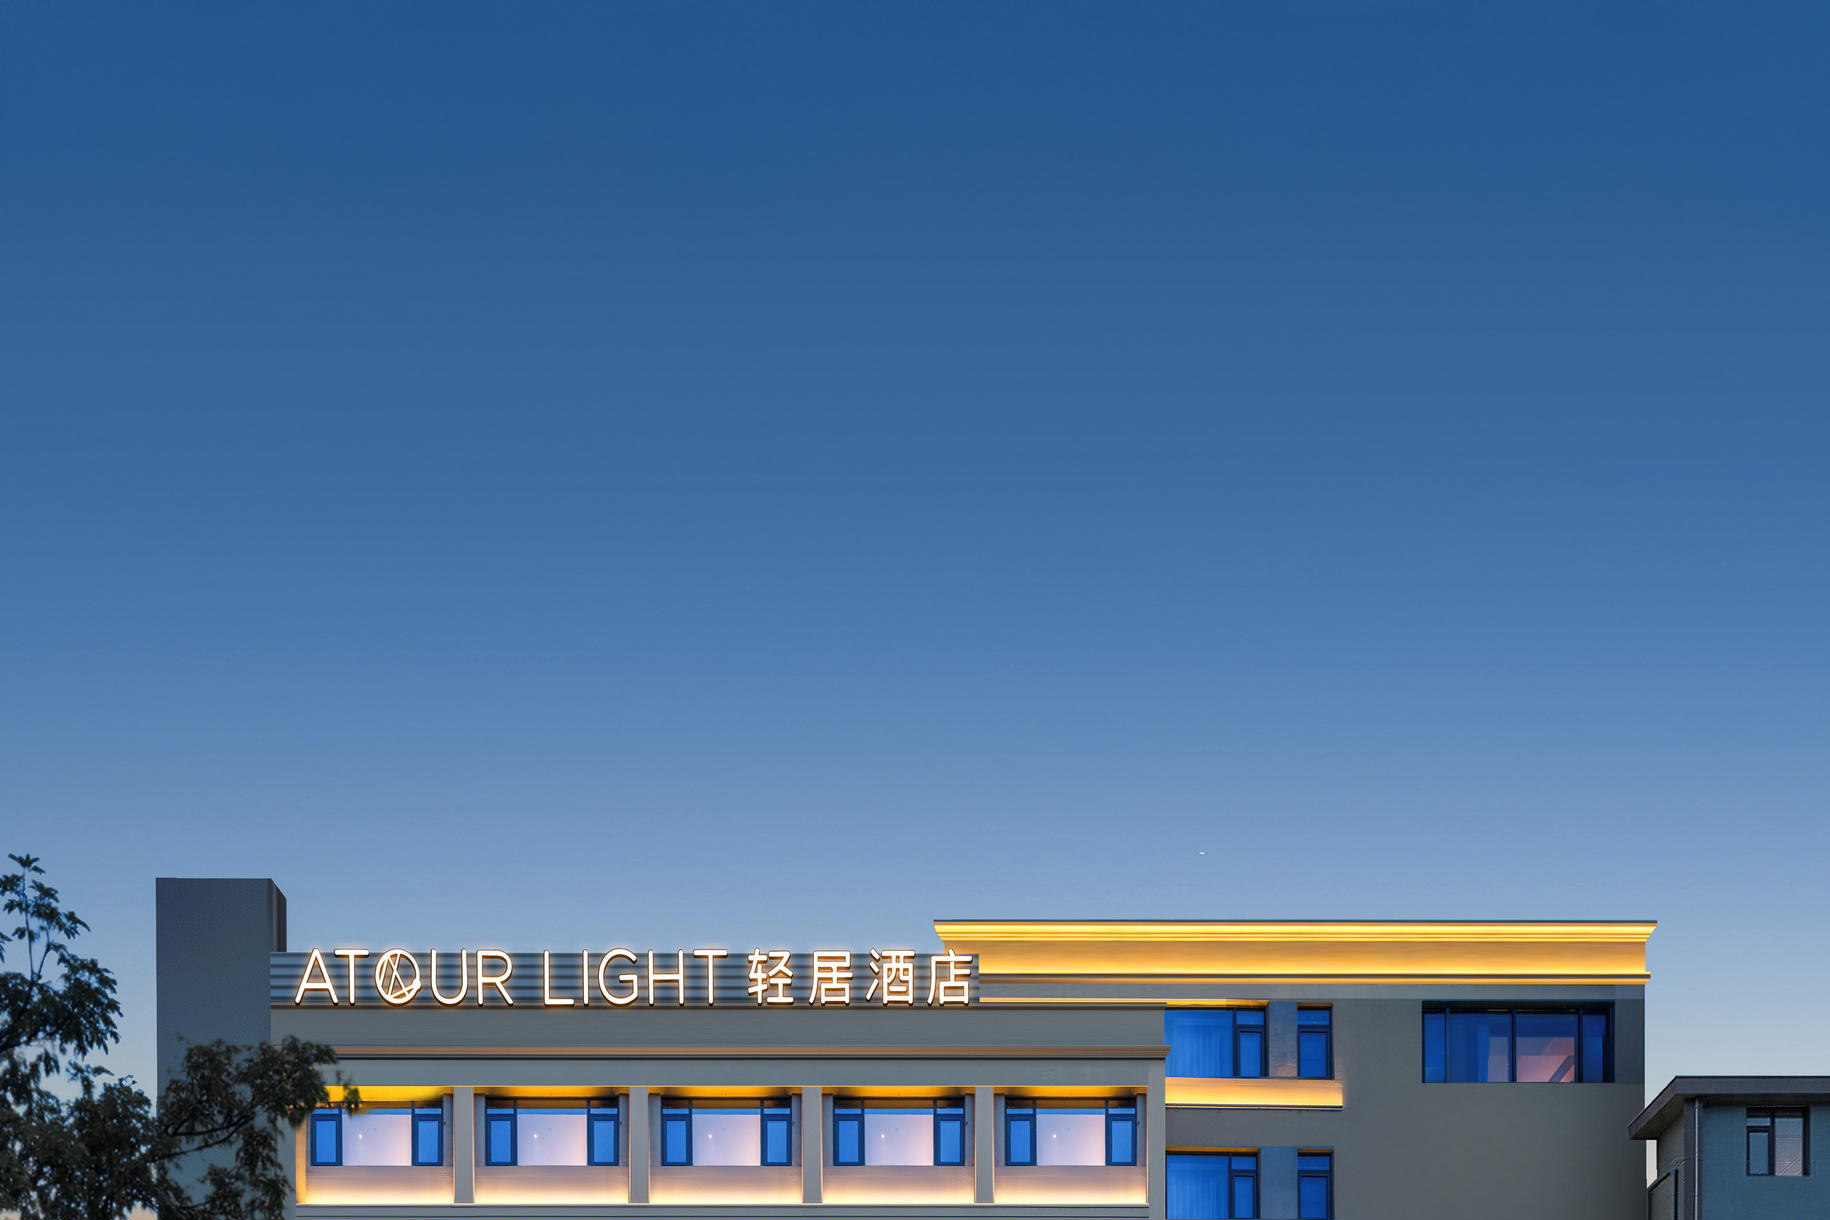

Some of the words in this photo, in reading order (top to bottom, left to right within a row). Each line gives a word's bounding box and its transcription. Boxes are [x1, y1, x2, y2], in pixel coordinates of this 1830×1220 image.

[295, 948, 513, 1005] ATOUR
[544, 948, 728, 1005] LIGHT
[747, 948, 973, 1005] 轻居酒店
